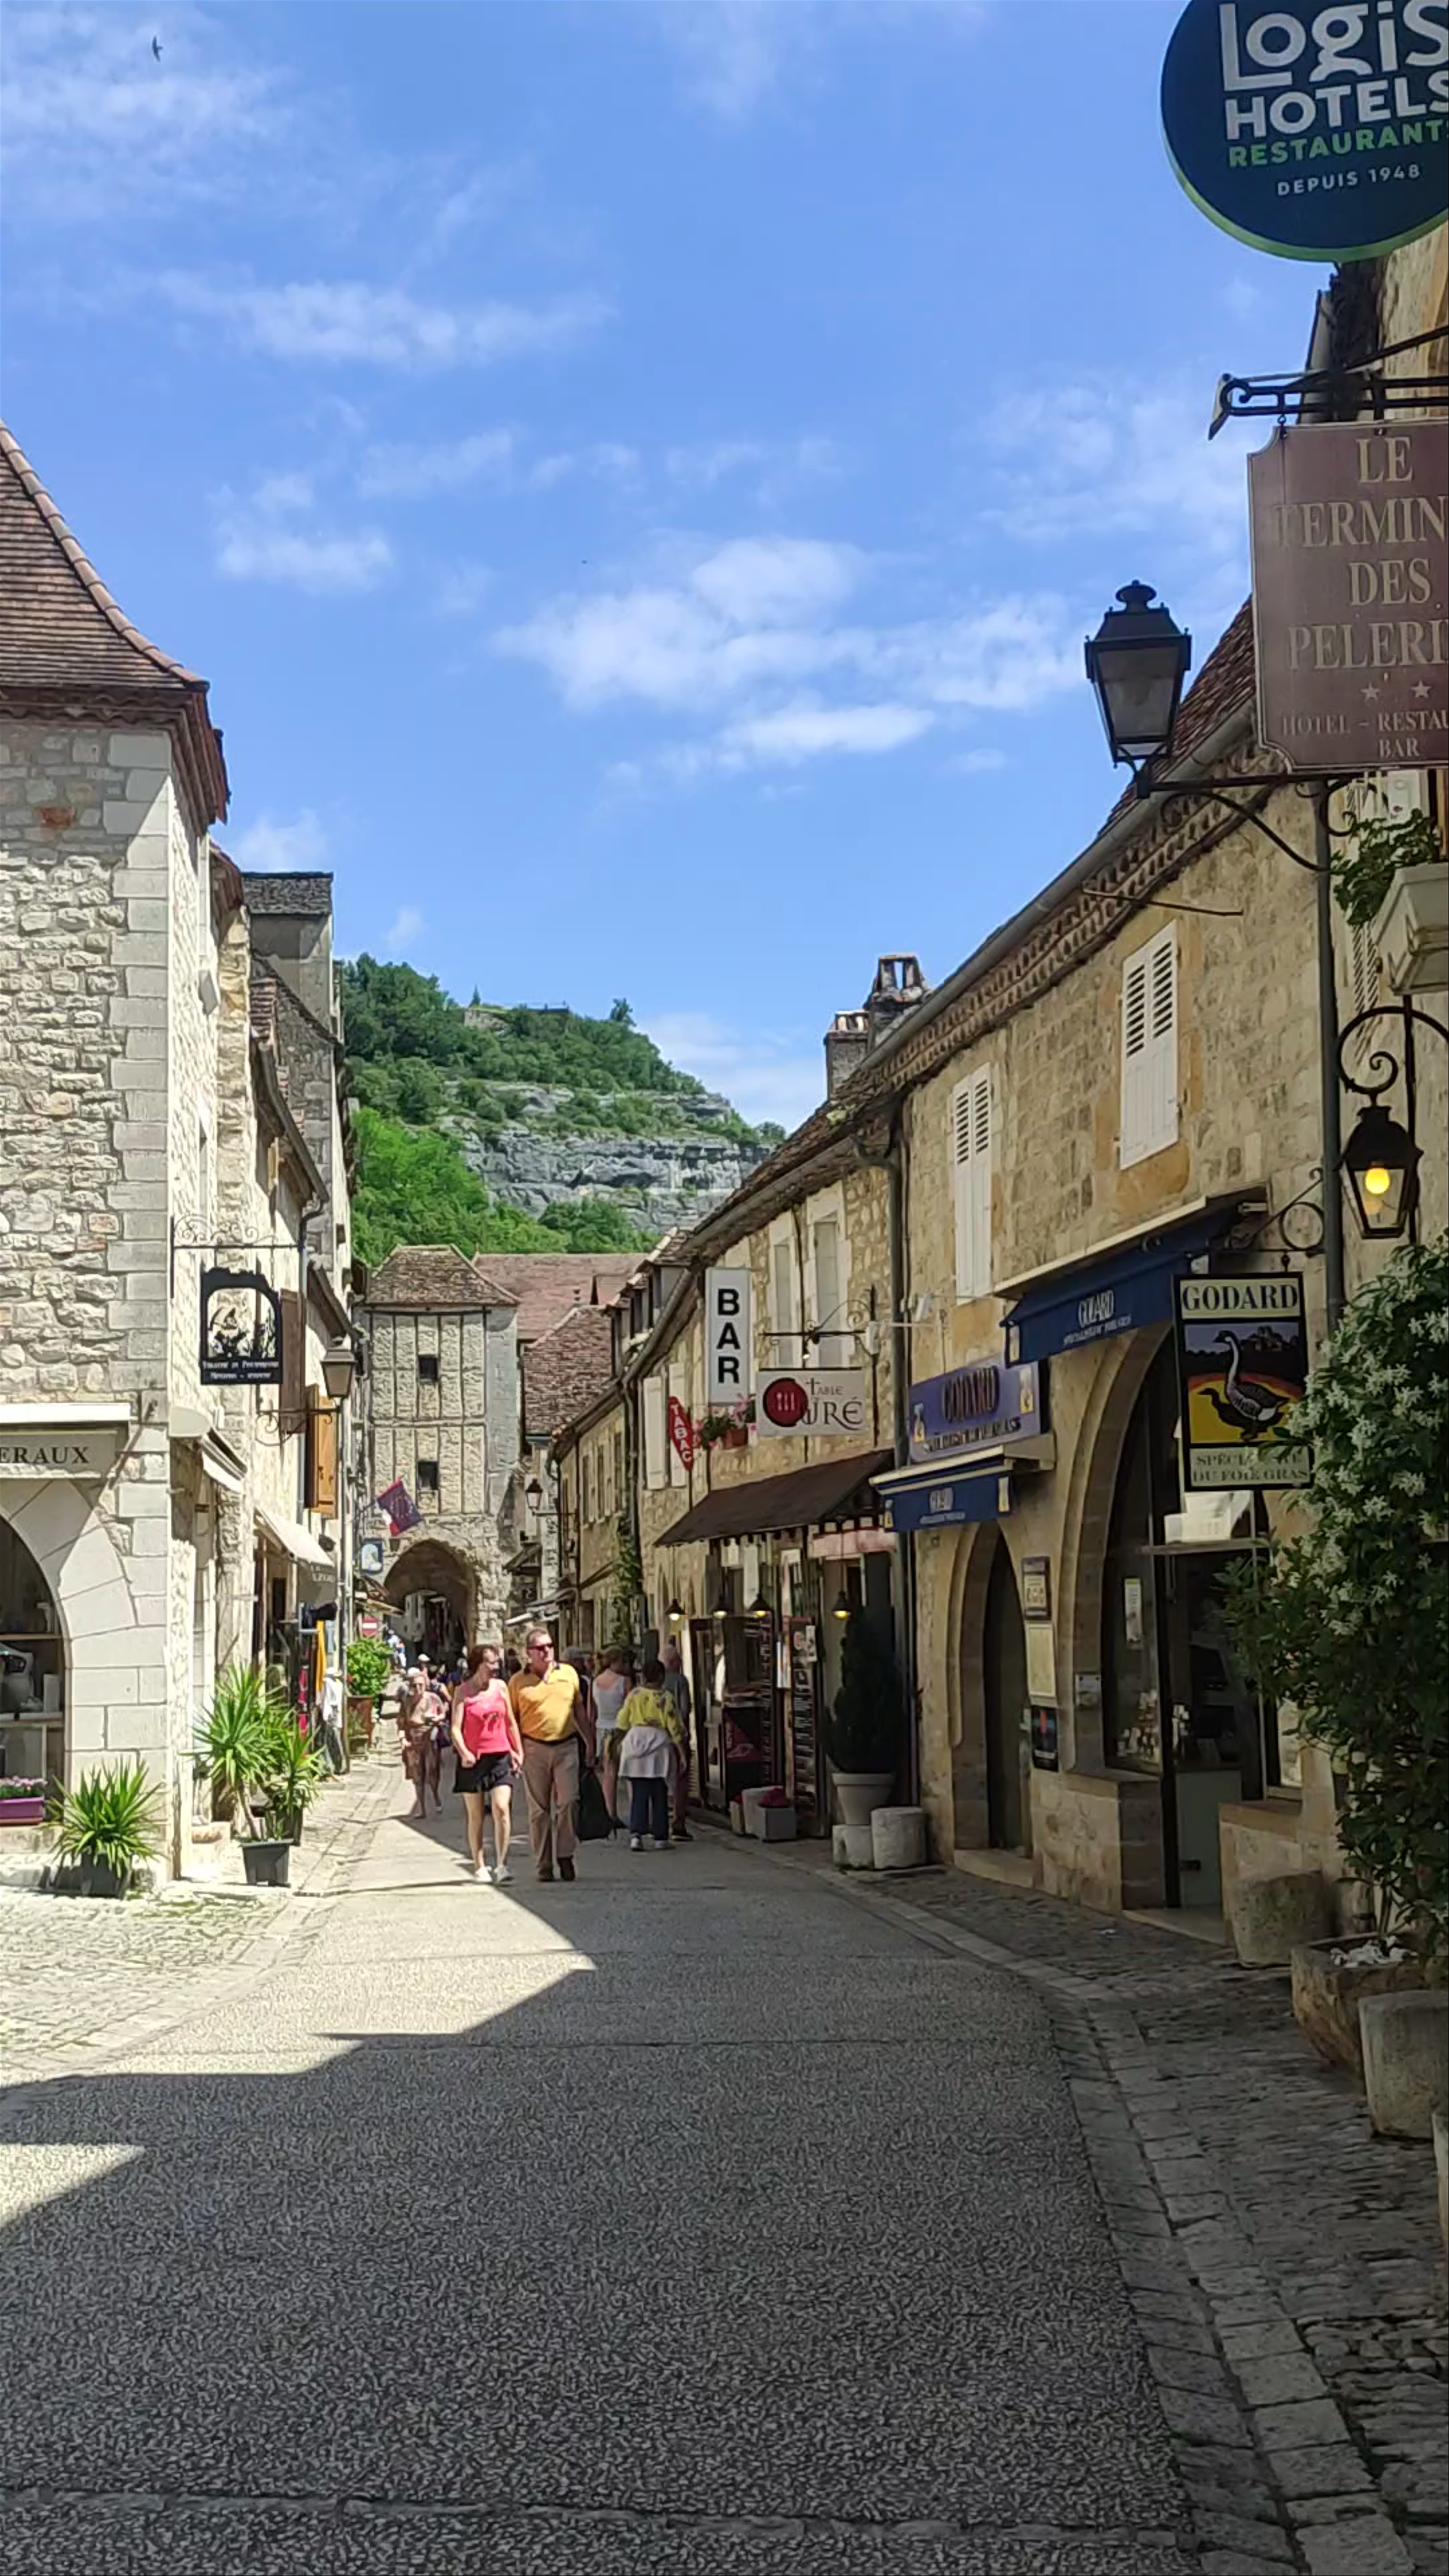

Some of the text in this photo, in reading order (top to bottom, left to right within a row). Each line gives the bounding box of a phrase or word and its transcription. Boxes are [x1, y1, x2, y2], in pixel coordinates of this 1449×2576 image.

[1220, 0, 1449, 91] Logis
[1225, 71, 1449, 140] HOTELS
[1229, 118, 1449, 168] RESTAURANT
[1278, 165, 1420, 195] DEPUIS 1948
[1356, 436, 1412, 483] LE
[1349, 558, 1432, 605] DES
[1287, 619, 1449, 670] PELERI
[1283, 713, 1351, 736] HOTEL
[1379, 737, 1420, 758] BAR
[1182, 1284, 1298, 1311] GODARD
[716, 1288, 741, 1384] BAR
[670, 1404, 693, 1463] TABAC
[1264, 1469, 1307, 1479] GRAS
